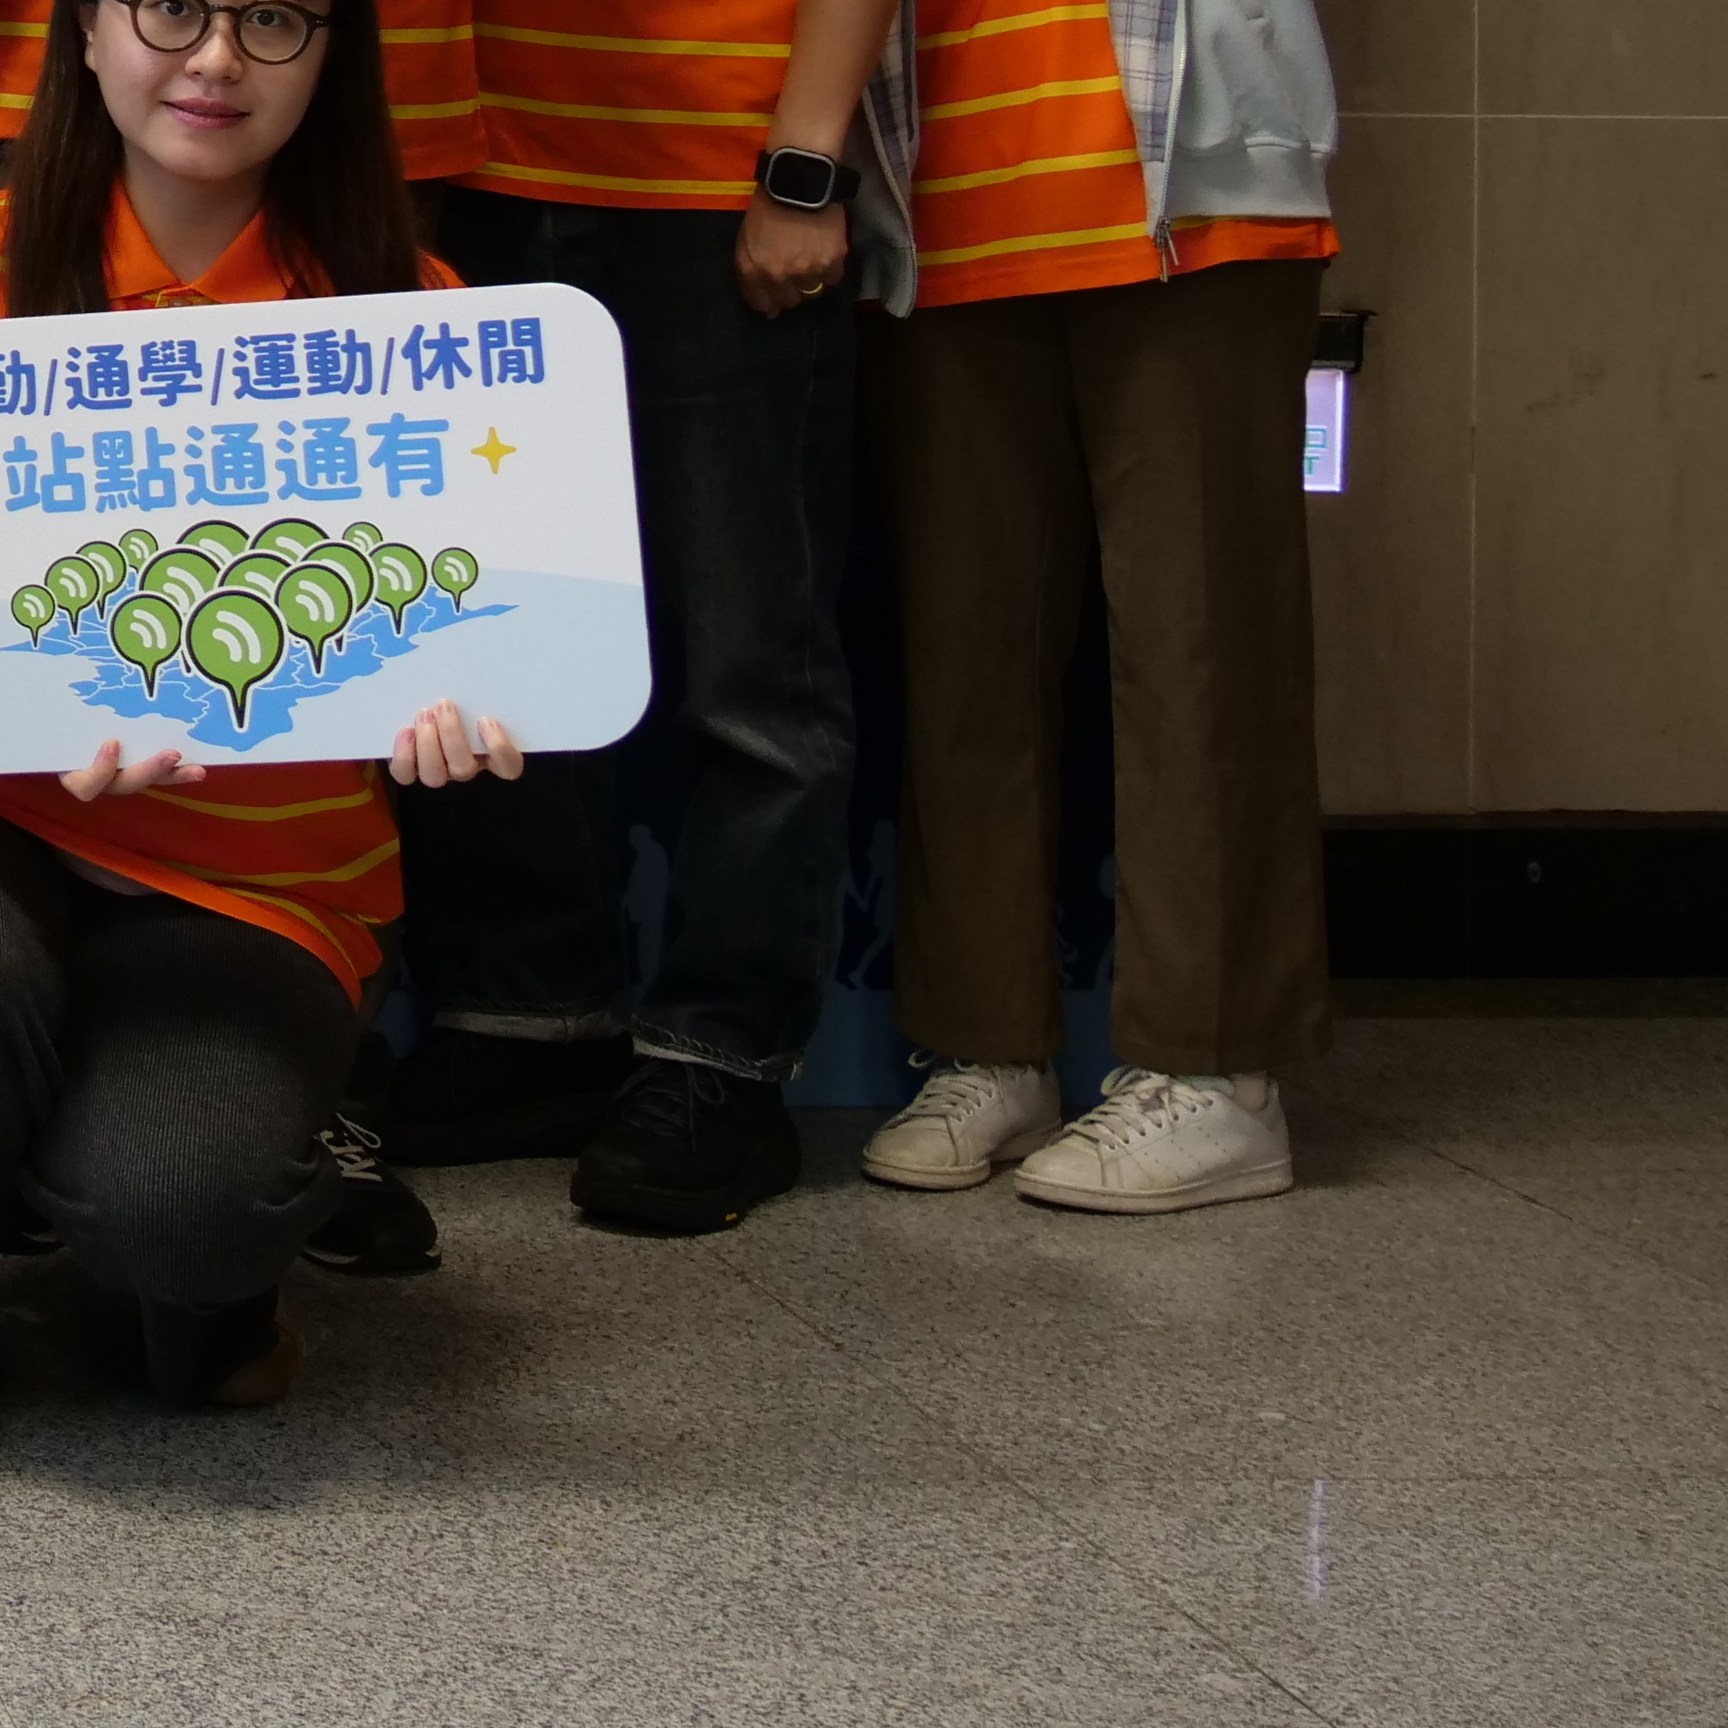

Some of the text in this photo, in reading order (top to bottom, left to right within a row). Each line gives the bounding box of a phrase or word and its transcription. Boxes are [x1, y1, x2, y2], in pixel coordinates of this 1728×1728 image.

[4, 412, 450, 514] 站點通通有
